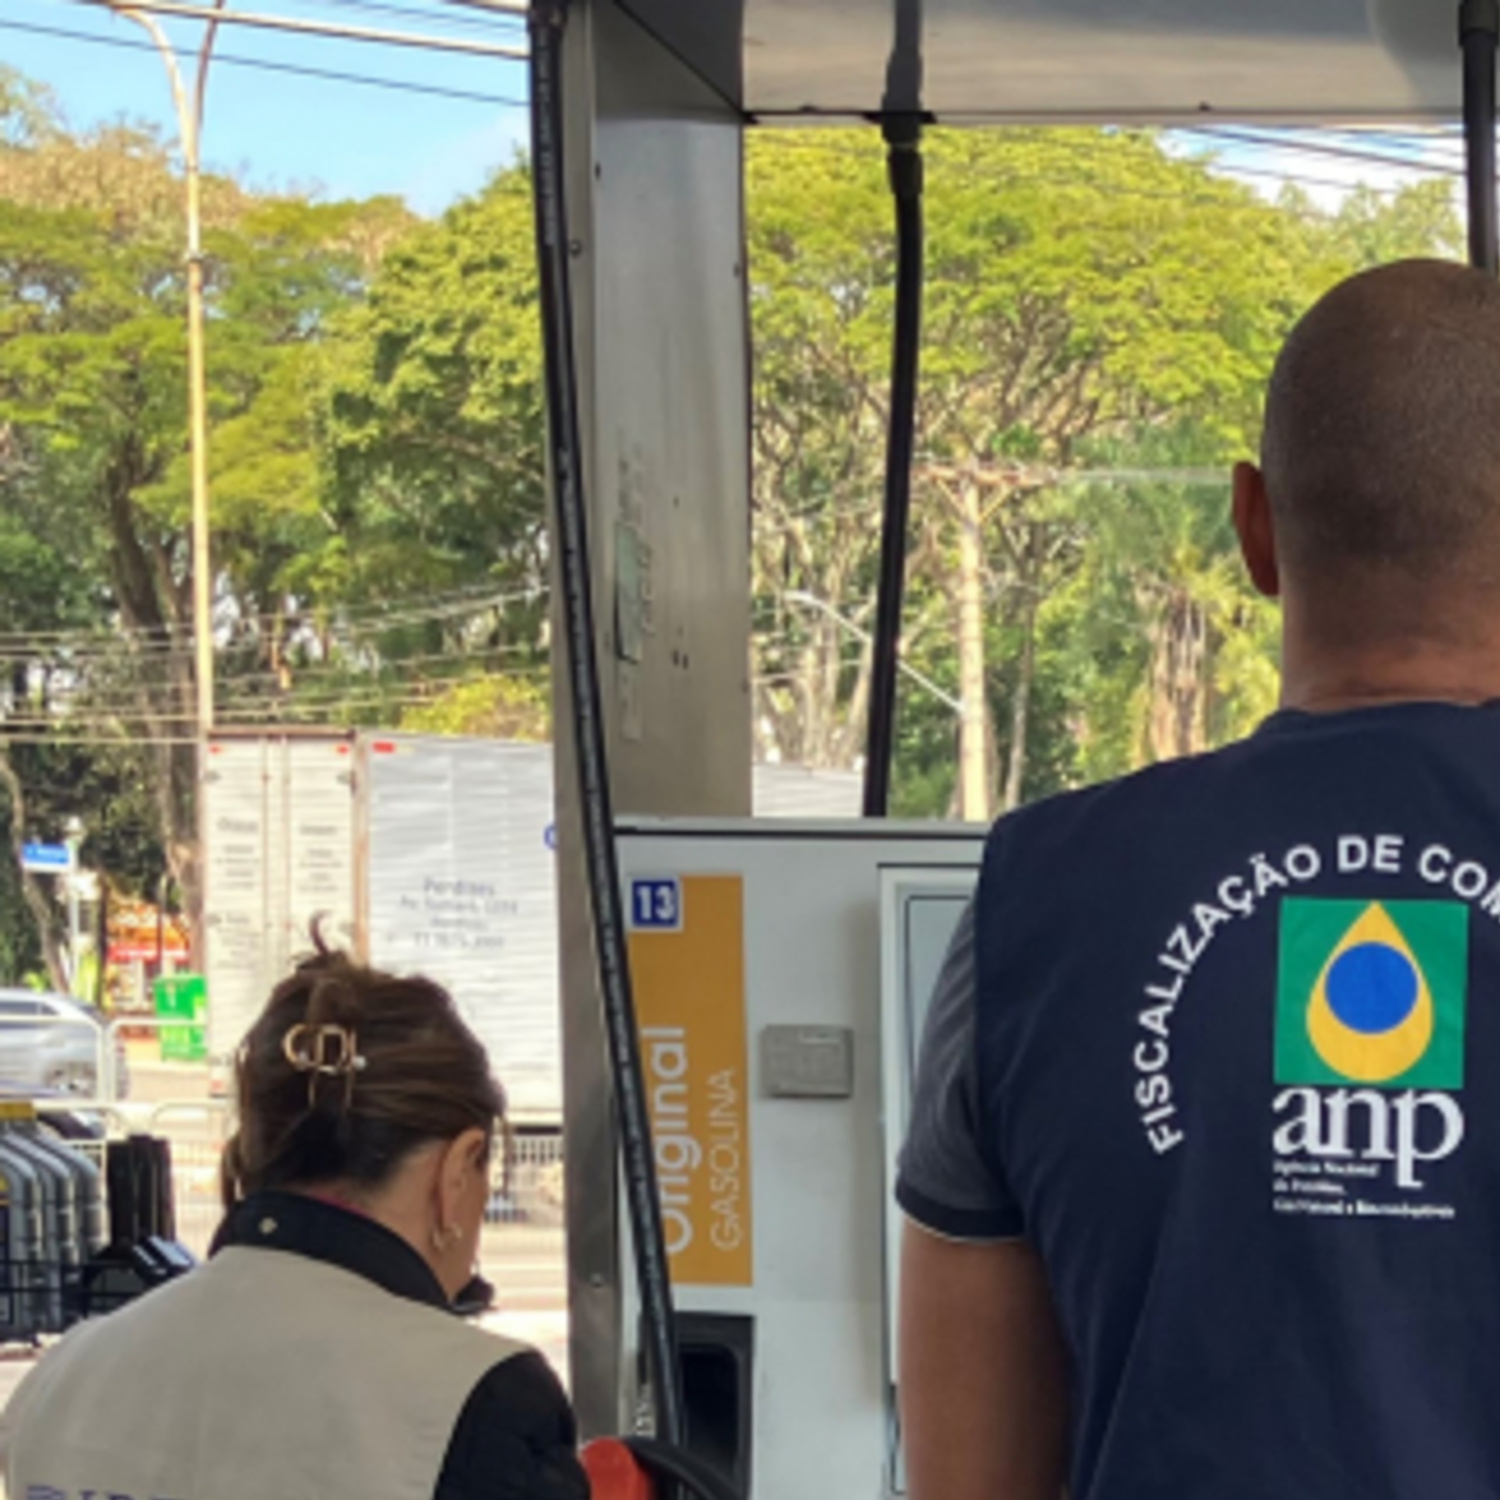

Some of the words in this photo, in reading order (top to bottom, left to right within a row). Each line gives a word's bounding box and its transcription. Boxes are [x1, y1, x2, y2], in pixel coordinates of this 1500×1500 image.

[635, 885, 677, 919] 13
[1133, 844, 1322, 1154] FISCALIZAÇÃO
[1337, 835, 1404, 873] DE
[708, 1067, 742, 1251] GASOLINA
[1272, 1086, 1465, 1187] anp
